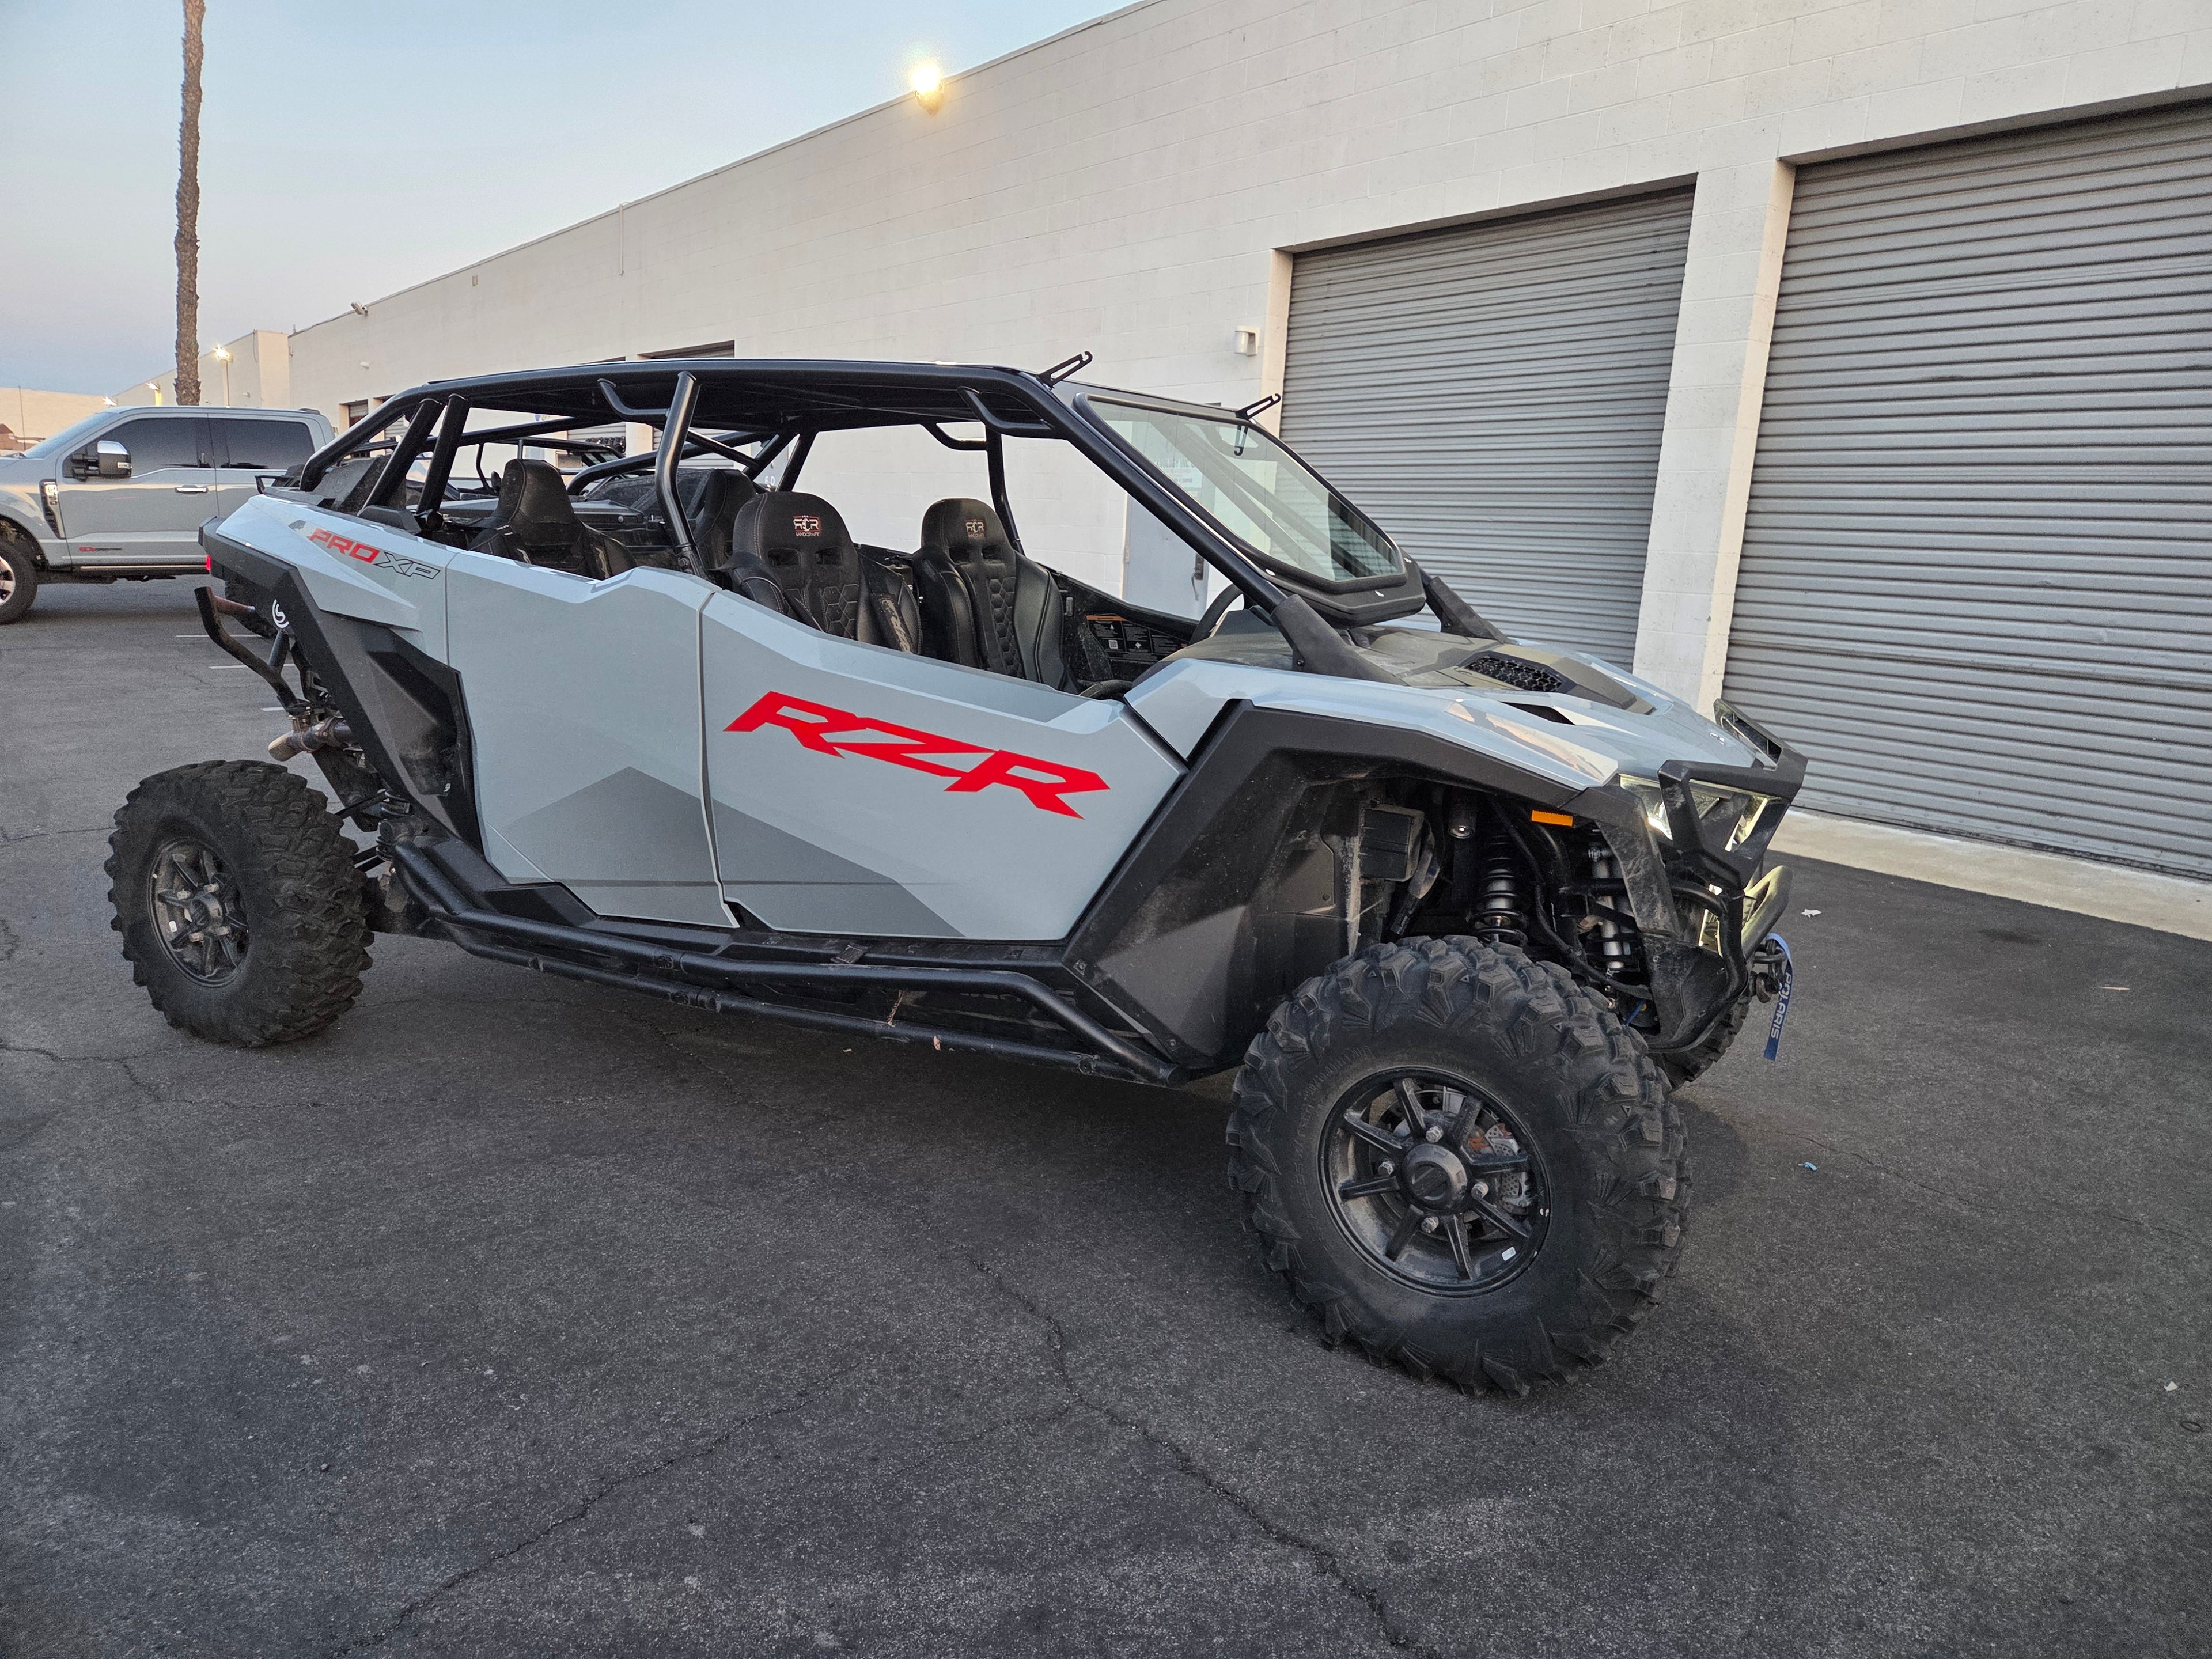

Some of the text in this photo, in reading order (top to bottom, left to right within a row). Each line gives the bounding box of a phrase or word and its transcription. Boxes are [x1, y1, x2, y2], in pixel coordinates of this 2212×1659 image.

[309, 528, 441, 580] PRO XP
[723, 691, 1111, 820] RZR
[1771, 972, 1792, 1039] POLARIS
